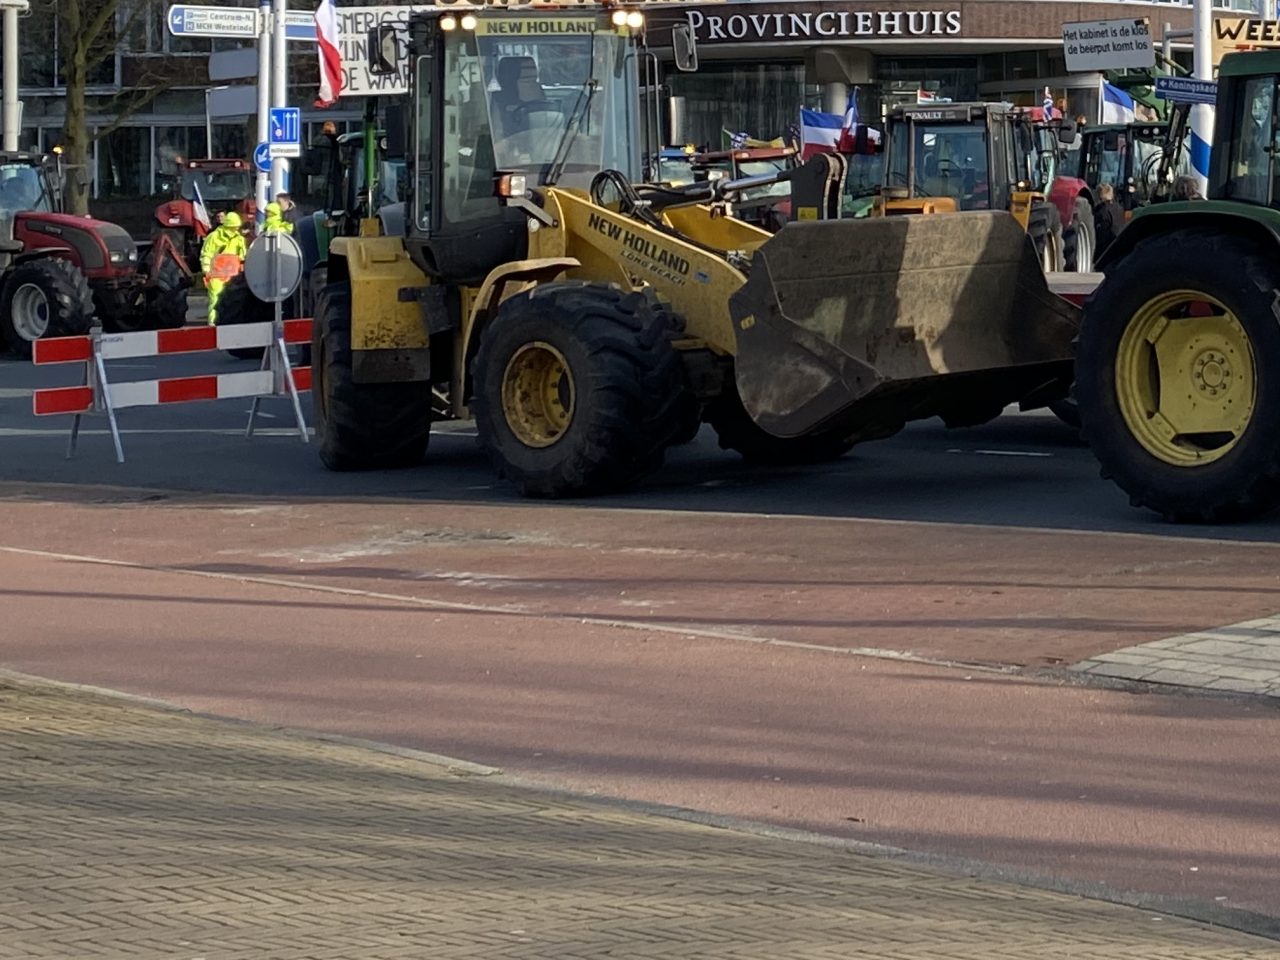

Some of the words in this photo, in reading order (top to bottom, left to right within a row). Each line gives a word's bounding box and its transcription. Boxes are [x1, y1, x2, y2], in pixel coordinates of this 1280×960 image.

[487, 22, 526, 33] NEW
[526, 20, 598, 33] HOLLAND
[685, 10, 962, 40] PROVINCIEHUIS
[1063, 30, 1078, 40] Het
[1079, 27, 1109, 39] kabinet
[1110, 27, 1118, 37] is
[1119, 26, 1130, 36] de
[1067, 44, 1078, 55] de
[1079, 43, 1111, 56] beerput
[1112, 41, 1134, 51] komt
[1135, 40, 1148, 50] los
[1168, 80, 1217, 93] Koningskad
[588, 213, 622, 240] NEW
[623, 230, 690, 275] HOLLAND
